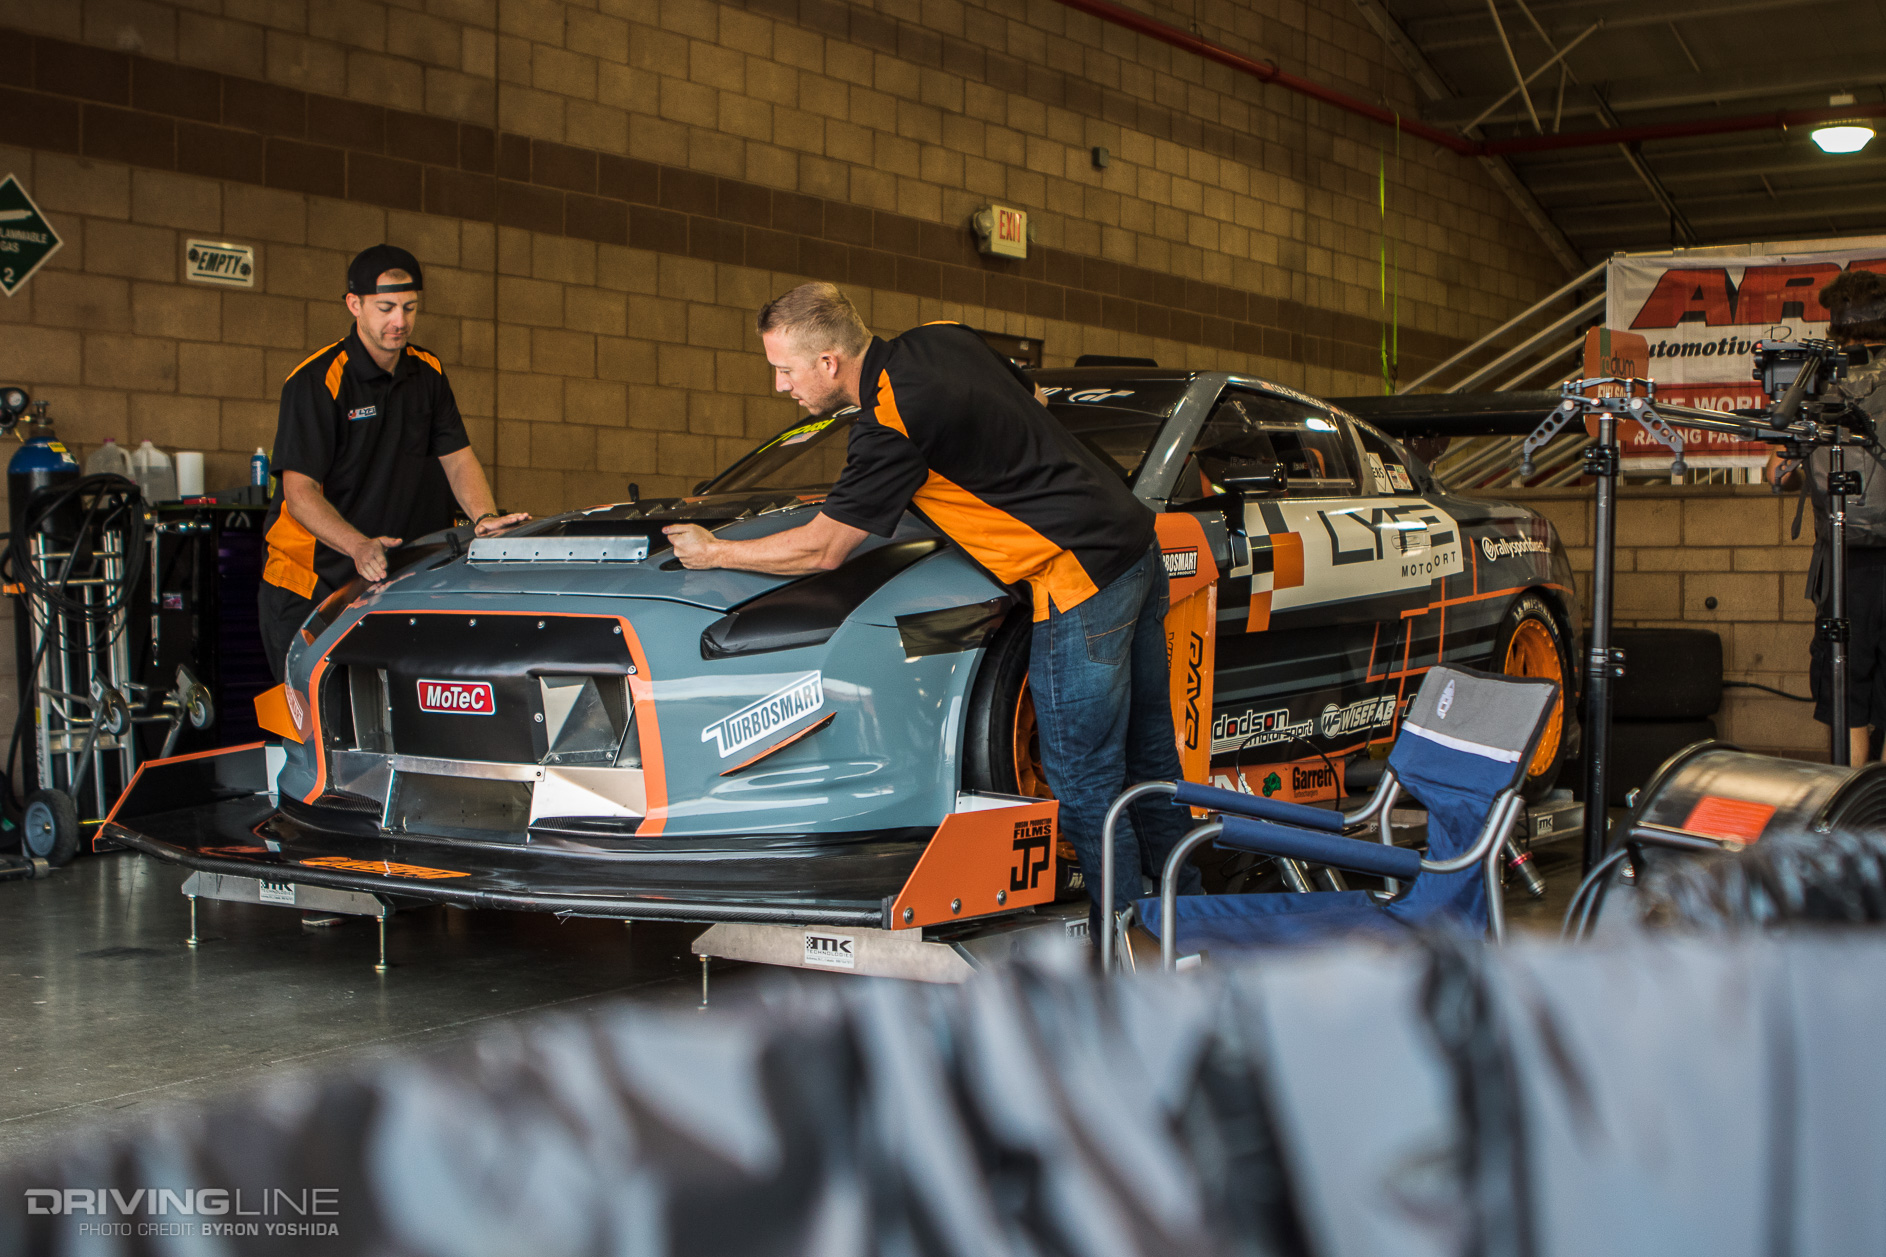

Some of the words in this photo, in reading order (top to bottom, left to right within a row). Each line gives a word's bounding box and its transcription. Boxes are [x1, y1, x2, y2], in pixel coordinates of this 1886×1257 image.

[999, 210, 1022, 243] EXIT
[4, 267, 14, 283] 2
[198, 251, 242, 274] EMPTY
[1629, 257, 1886, 328] AR
[1163, 552, 1198, 572] BOSMART
[426, 685, 485, 710] MoTeC
[1185, 631, 1204, 751] RAYS
[705, 672, 820, 751] TURBOSMART
[1213, 709, 1289, 741] dodson
[1341, 700, 1396, 731] WISEFAB
[1013, 824, 1052, 839] FILMS
